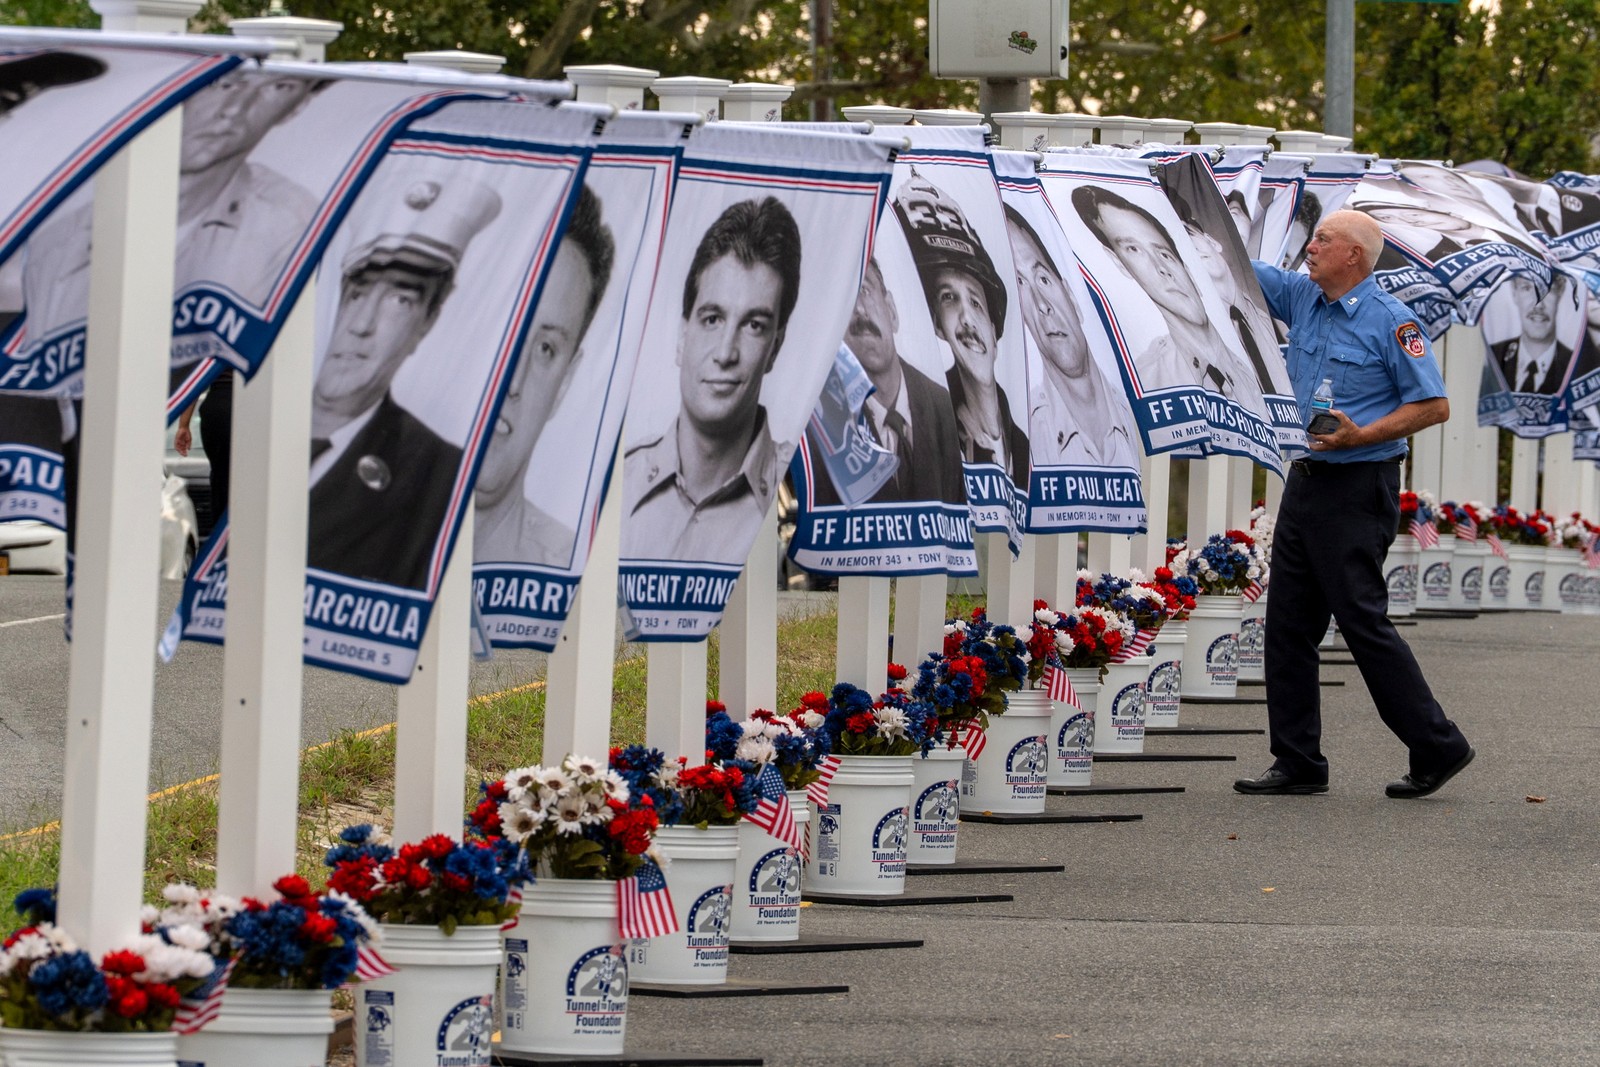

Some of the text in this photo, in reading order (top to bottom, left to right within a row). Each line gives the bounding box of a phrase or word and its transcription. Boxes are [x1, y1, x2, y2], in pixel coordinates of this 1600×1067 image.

[1440, 257, 1469, 277] LT.
[1148, 398, 1173, 423] FF
[1171, 429, 1183, 440] IN
[1185, 424, 1209, 436] MEM
[1278, 432, 1291, 441] FDNY
[1040, 477, 1058, 501] FF
[1065, 476, 1104, 500] PAUL
[9, 498, 38, 511] 343
[980, 511, 999, 522] 343
[1047, 513, 1056, 522] IN
[1057, 512, 1087, 522] MEMORY
[1087, 511, 1097, 521] 343
[1106, 513, 1121, 523] FDNY
[811, 517, 838, 545] FF
[842, 514, 913, 544] JEFFREY
[820, 556, 833, 566] IN
[836, 555, 882, 567] MEMORY
[885, 554, 902, 565] 343
[918, 552, 941, 563] FDNY
[966, 556, 973, 566] 3
[489, 576, 580, 614] BARRY
[644, 617, 659, 628] 343
[677, 618, 698, 629] FDNY
[495, 622, 558, 639] LADDER 15
[321, 639, 392, 666] LADDER 5
[1058, 748, 1080, 757] Tunnel
[1005, 773, 1030, 783] Tunnel
[914, 821, 940, 831] Tunnel
[872, 850, 896, 861] Tunnel
[761, 859, 799, 893] 25
[749, 894, 779, 905] Tunnel
[758, 907, 797, 918] Foundation
[686, 935, 715, 947] Tunnel
[580, 959, 626, 998] 25
[566, 999, 600, 1012] Tunnel
[576, 1014, 622, 1027] Foundation
[436, 1054, 471, 1067] Tunnel
